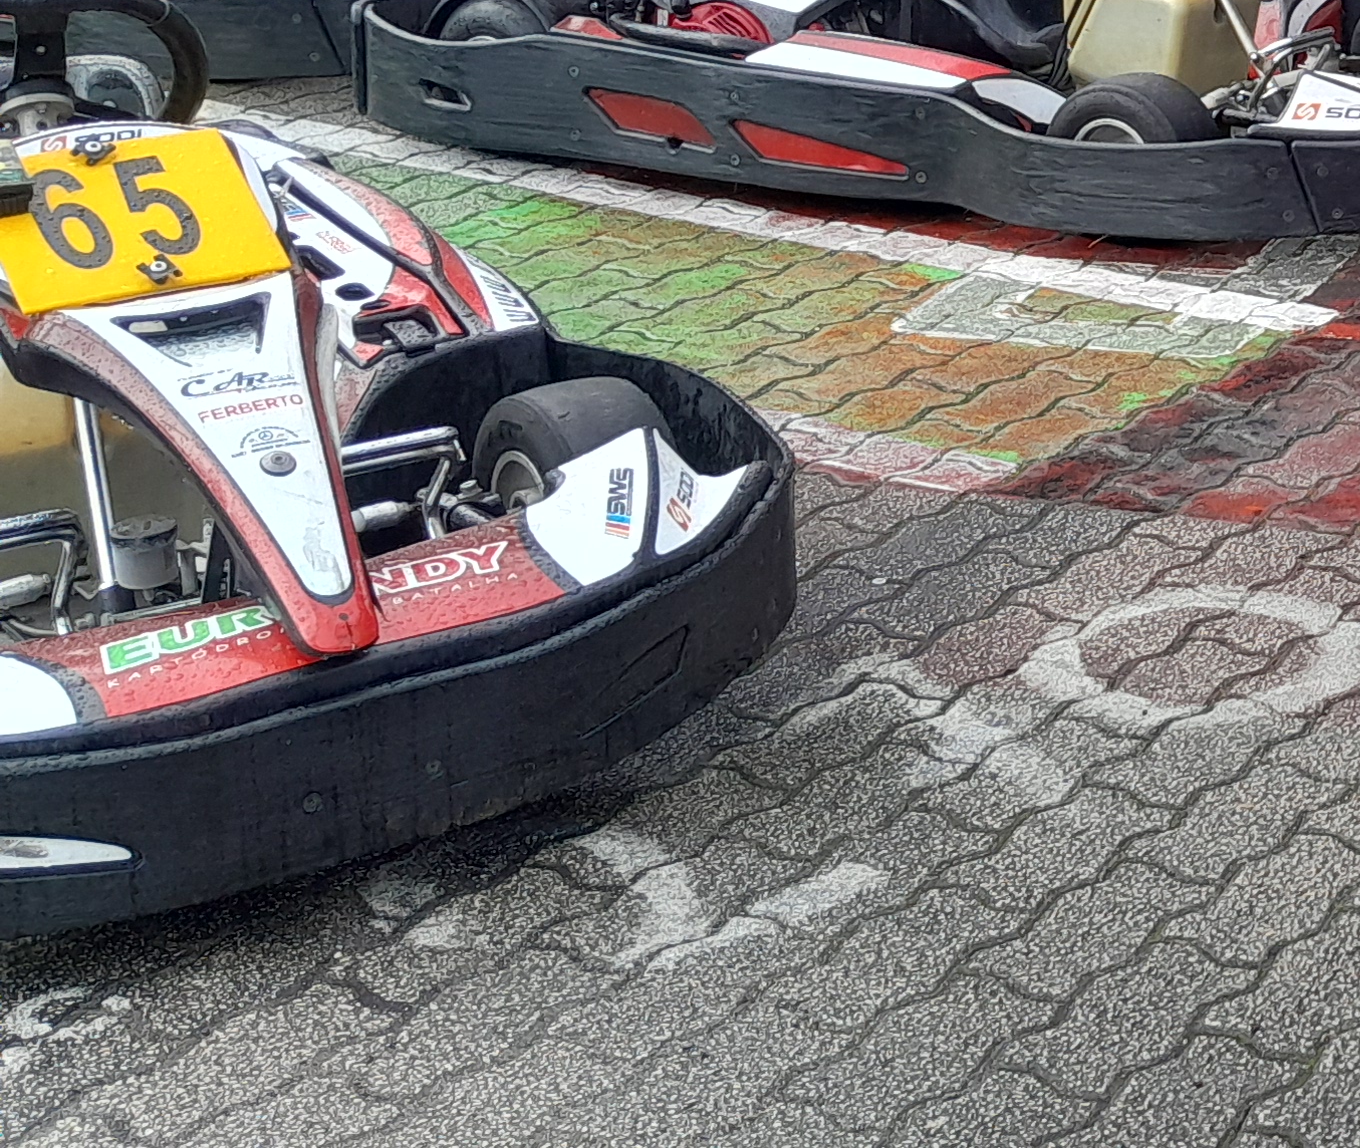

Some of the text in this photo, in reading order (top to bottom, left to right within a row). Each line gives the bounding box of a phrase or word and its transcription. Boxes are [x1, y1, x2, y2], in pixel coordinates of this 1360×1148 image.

[28, 154, 202, 270] 65
[197, 393, 304, 424] FERBERTO
[606, 467, 634, 517] SWS
[392, 572, 519, 605] BATALHA
